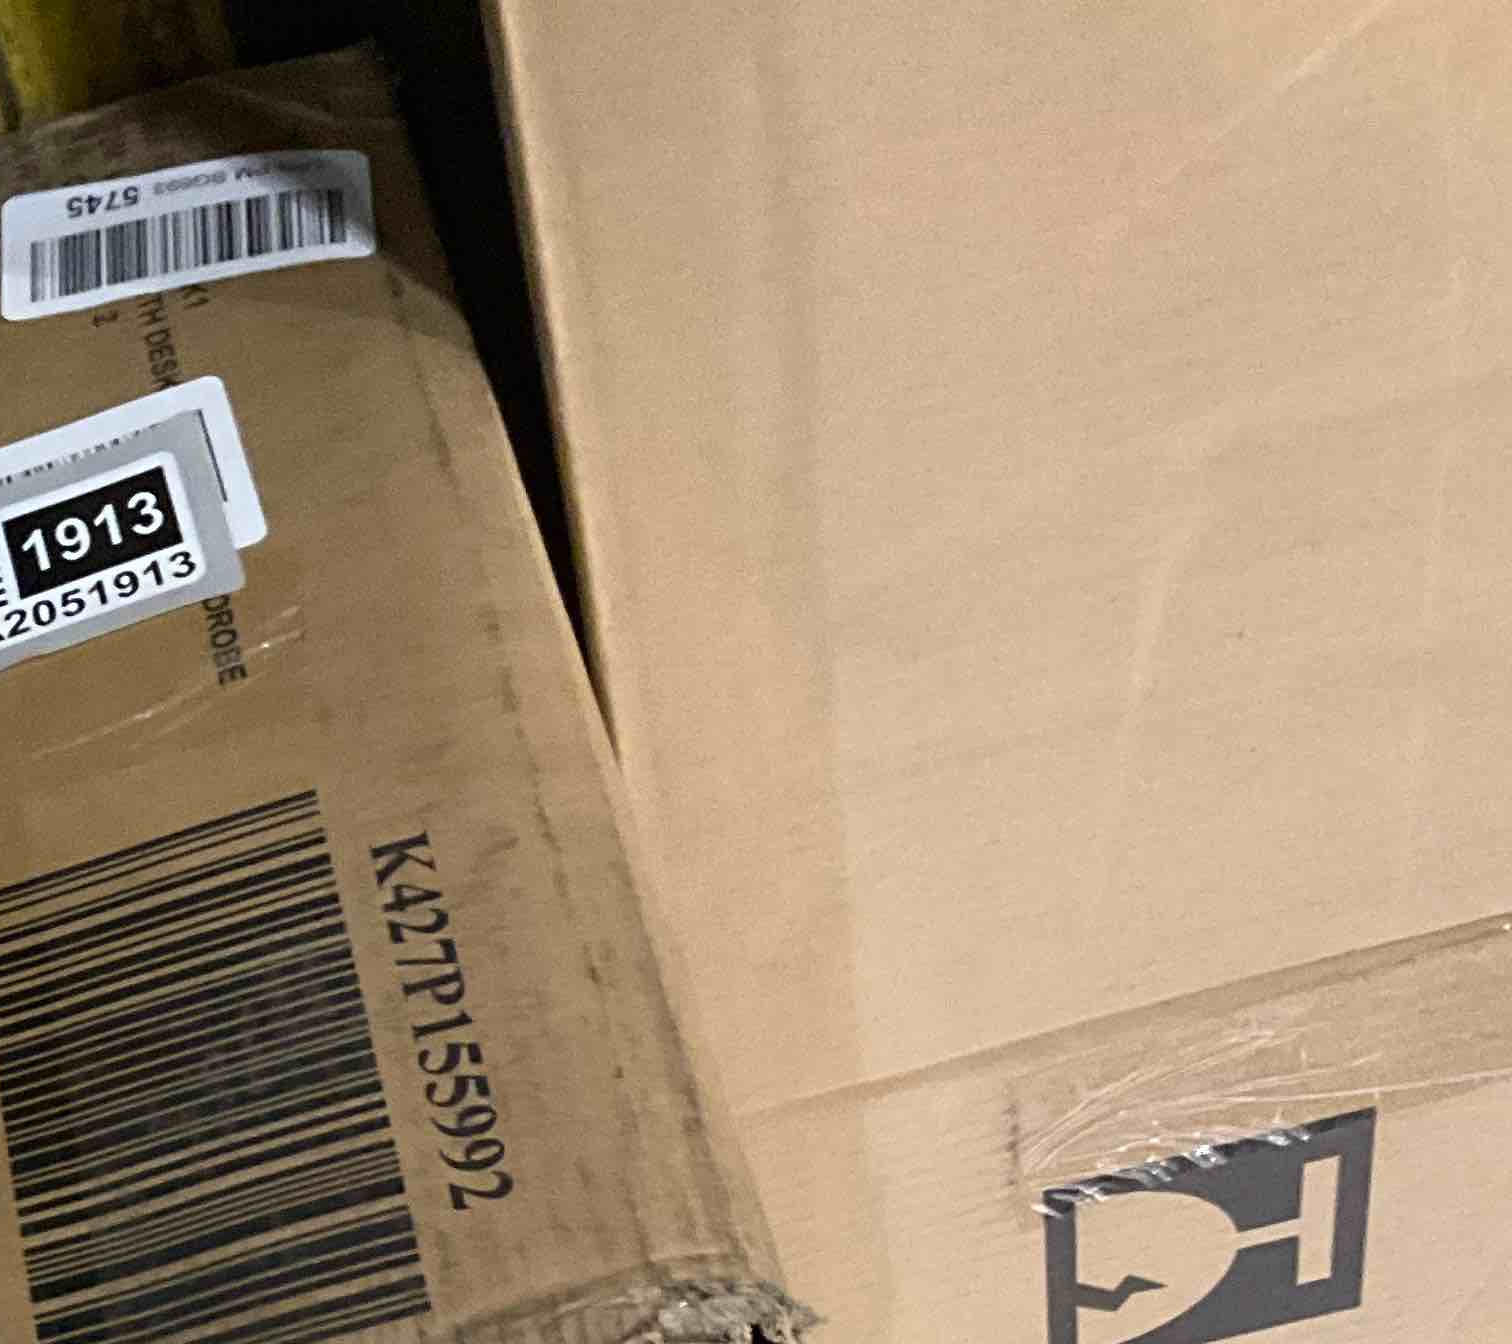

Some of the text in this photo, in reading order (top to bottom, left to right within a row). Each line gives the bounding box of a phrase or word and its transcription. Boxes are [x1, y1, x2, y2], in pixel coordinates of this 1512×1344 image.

[66, 185, 140, 219] 5745
[20, 490, 166, 573] 1913
[368, 830, 515, 1212] K427P155992
